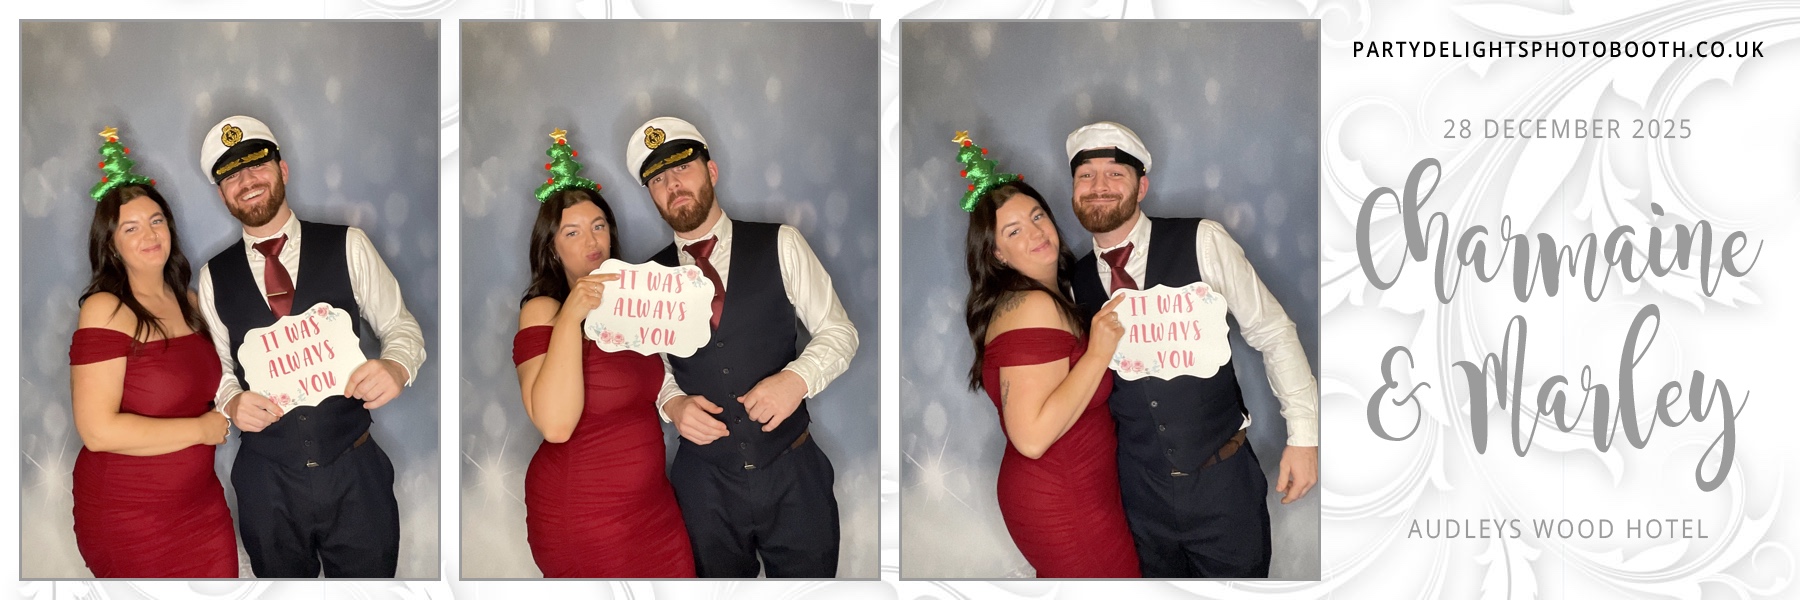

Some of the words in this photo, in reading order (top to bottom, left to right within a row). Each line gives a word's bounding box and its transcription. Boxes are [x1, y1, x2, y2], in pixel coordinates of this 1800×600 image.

[619, 269, 639, 290] IT
[647, 272, 684, 294] WAS
[613, 297, 687, 322] ALWAYS
[1129, 295, 1148, 316] IT
[1157, 292, 1194, 314] WAS
[260, 330, 280, 353] IT
[285, 315, 320, 344] WAS
[639, 327, 677, 346] YOU
[1129, 320, 1201, 343] ALWAYS
[268, 339, 335, 379] ALWAYS
[1157, 350, 1195, 369] YOU
[298, 370, 337, 396] YOU
